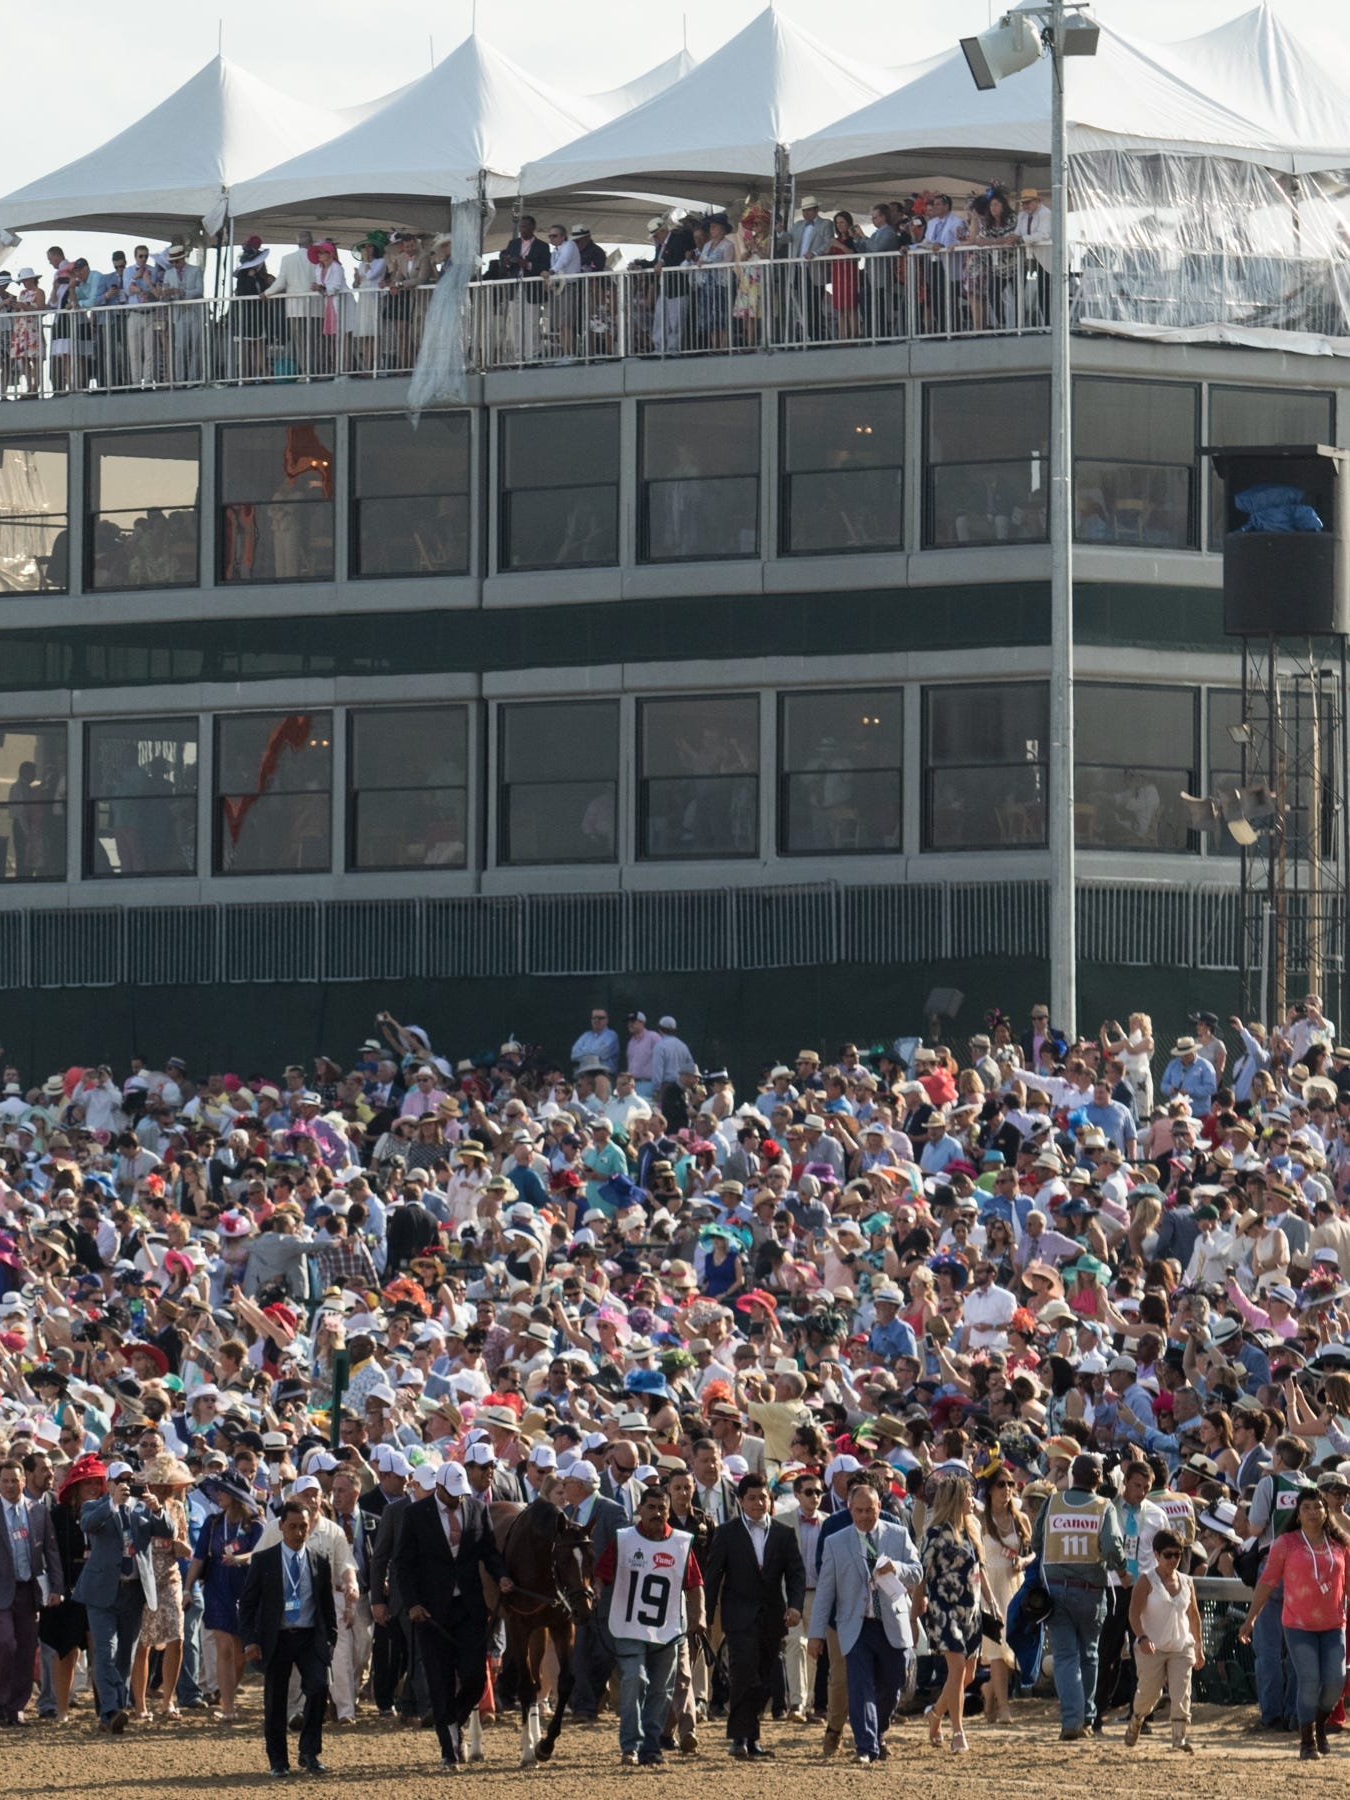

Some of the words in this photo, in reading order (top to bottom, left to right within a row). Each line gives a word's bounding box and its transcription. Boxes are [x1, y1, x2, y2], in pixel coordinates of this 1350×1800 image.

[1052, 1517, 1098, 1530] Canon
[1061, 1535, 1088, 1556] 111
[625, 1570, 671, 1629] 19
